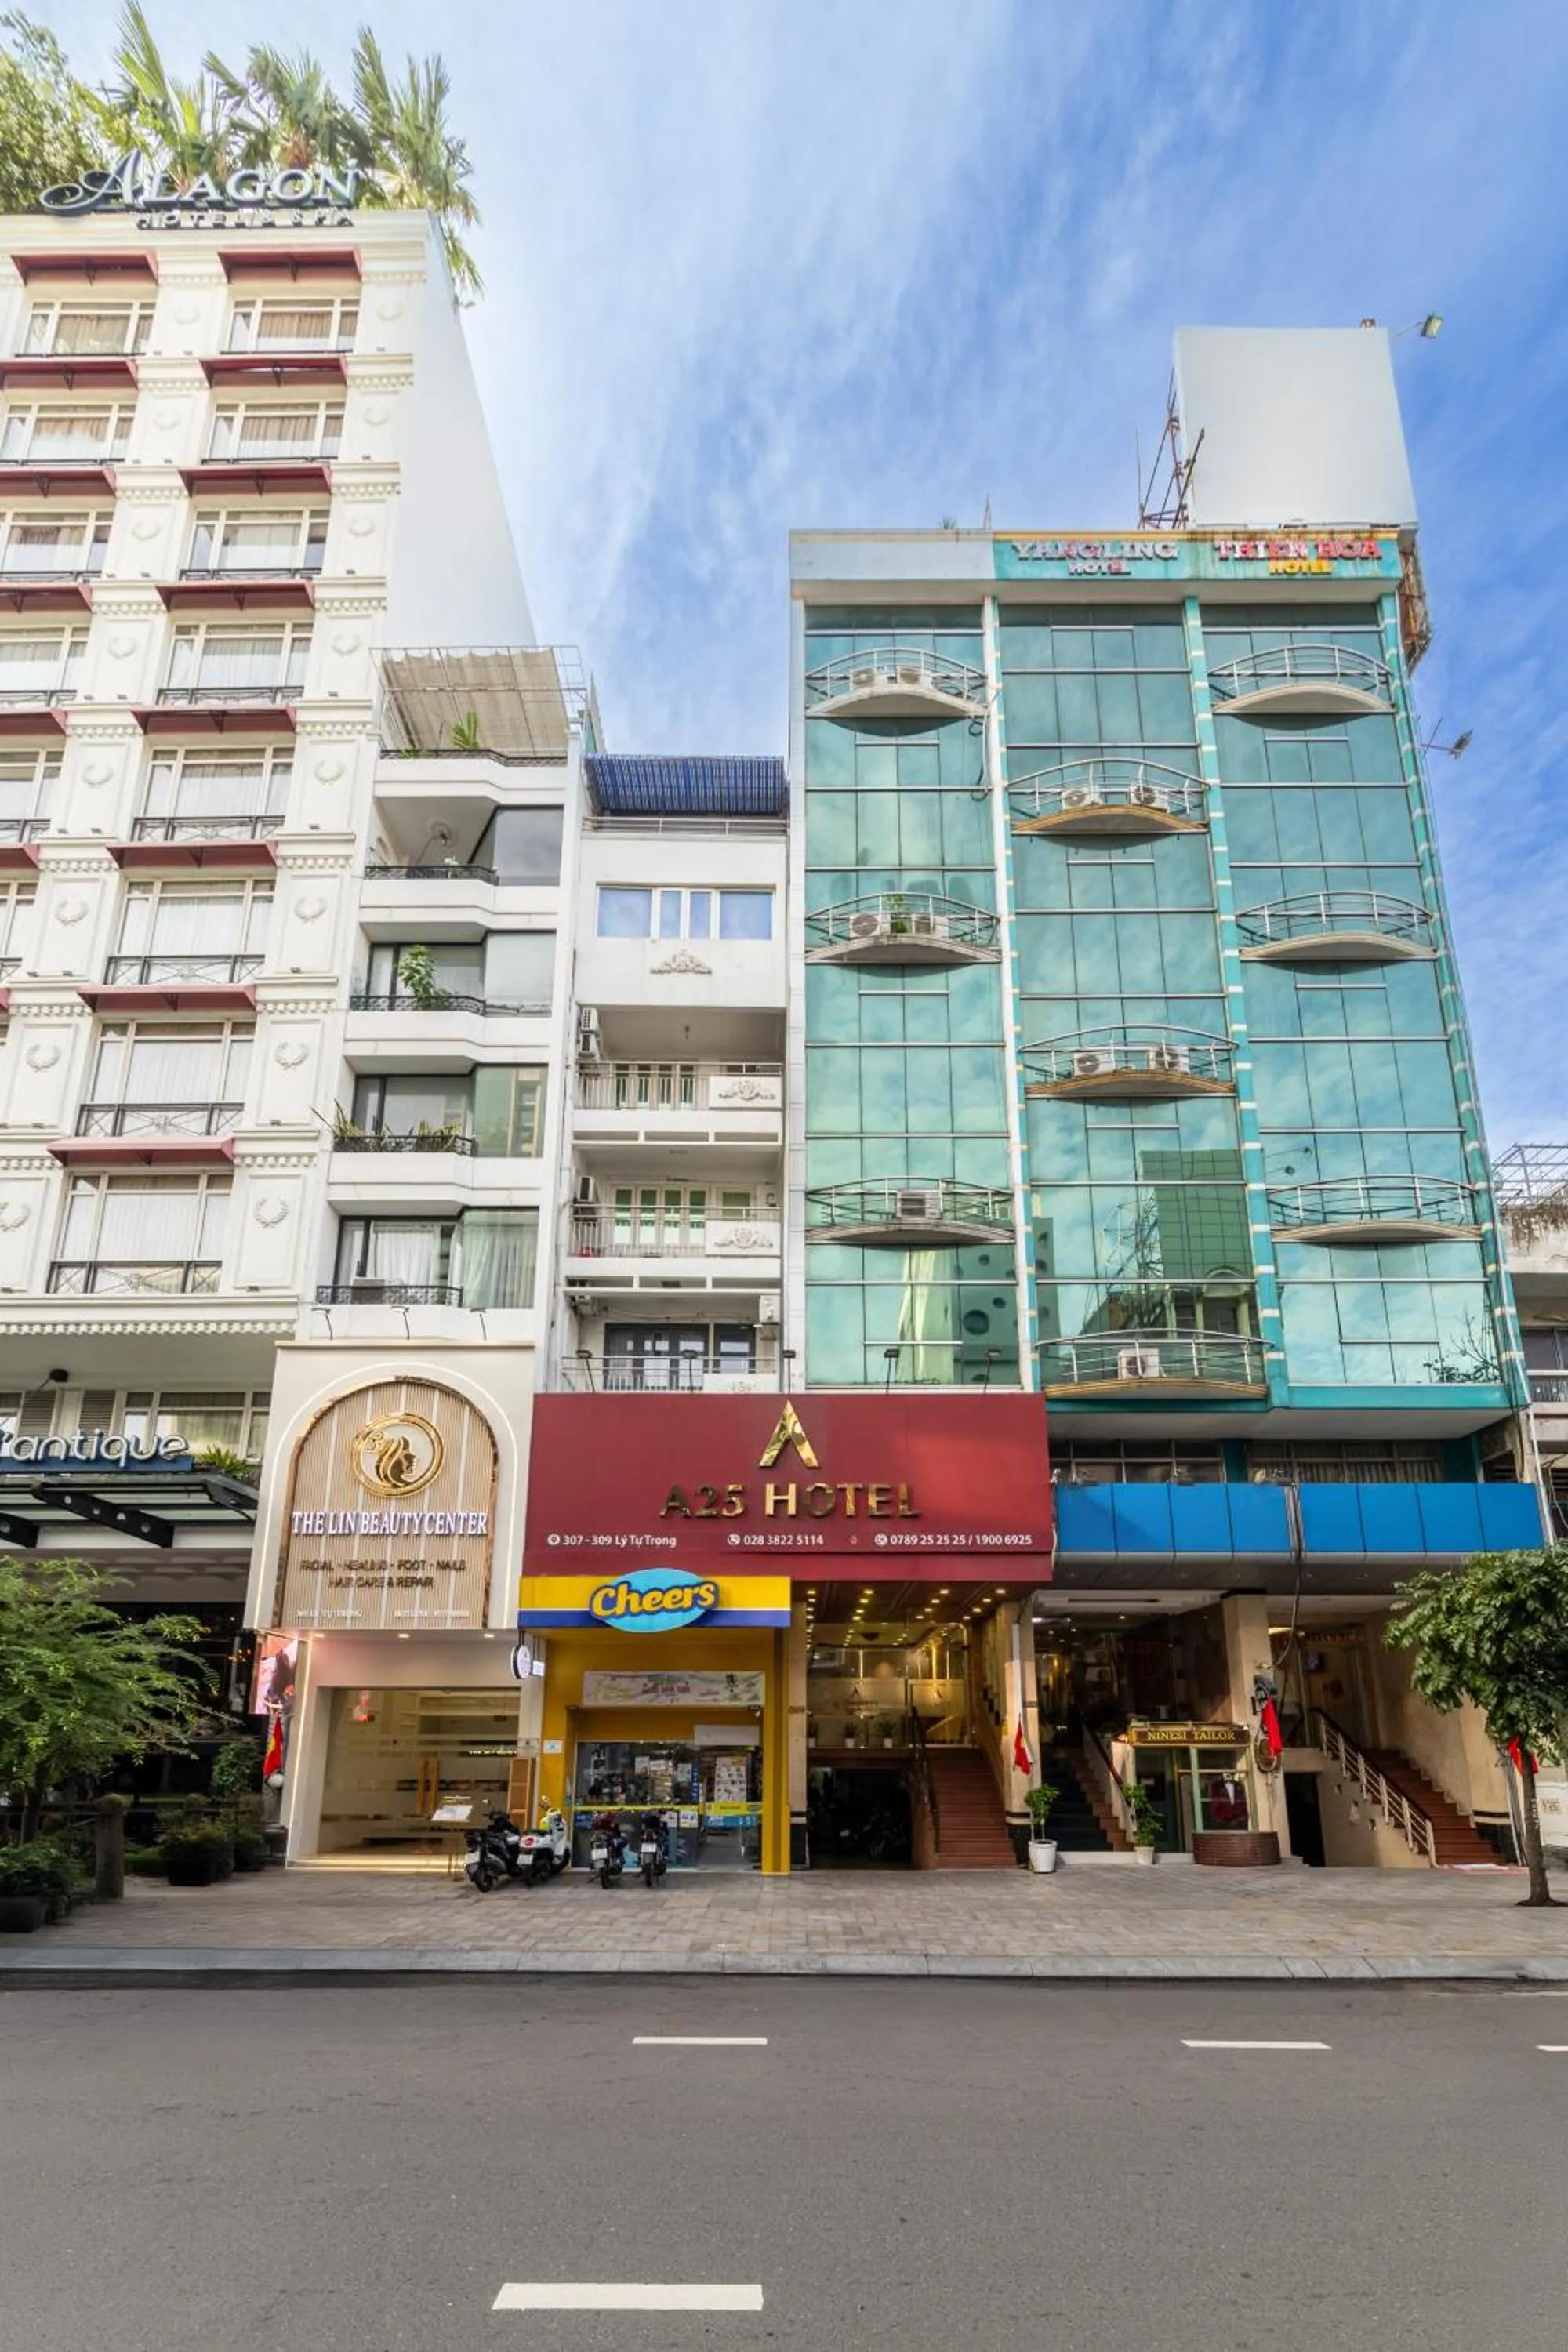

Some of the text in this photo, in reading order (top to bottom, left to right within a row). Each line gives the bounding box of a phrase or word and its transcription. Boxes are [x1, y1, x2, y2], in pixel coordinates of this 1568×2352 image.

[659, 1483, 921, 1519] A25 HOTEL
[293, 1512, 488, 1534] THE LIN BEAUTY CENTER
[563, 1534, 581, 1546] 307
[591, 1534, 612, 1546] 309
[743, 1534, 824, 1545] 028 3822 5114
[890, 1534, 918, 1545] 0789
[920, 1534, 935, 1545] 25
[936, 1534, 950, 1545] 25
[953, 1534, 967, 1545] 25
[975, 1534, 1003, 1545] 1900
[1004, 1534, 1032, 1545] 6925
[397, 1560, 426, 1571] FOOT
[397, 1577, 434, 1588] REPAIR
[589, 1579, 719, 1620] Cheers
[1195, 1730, 1236, 1740] TAILOR
